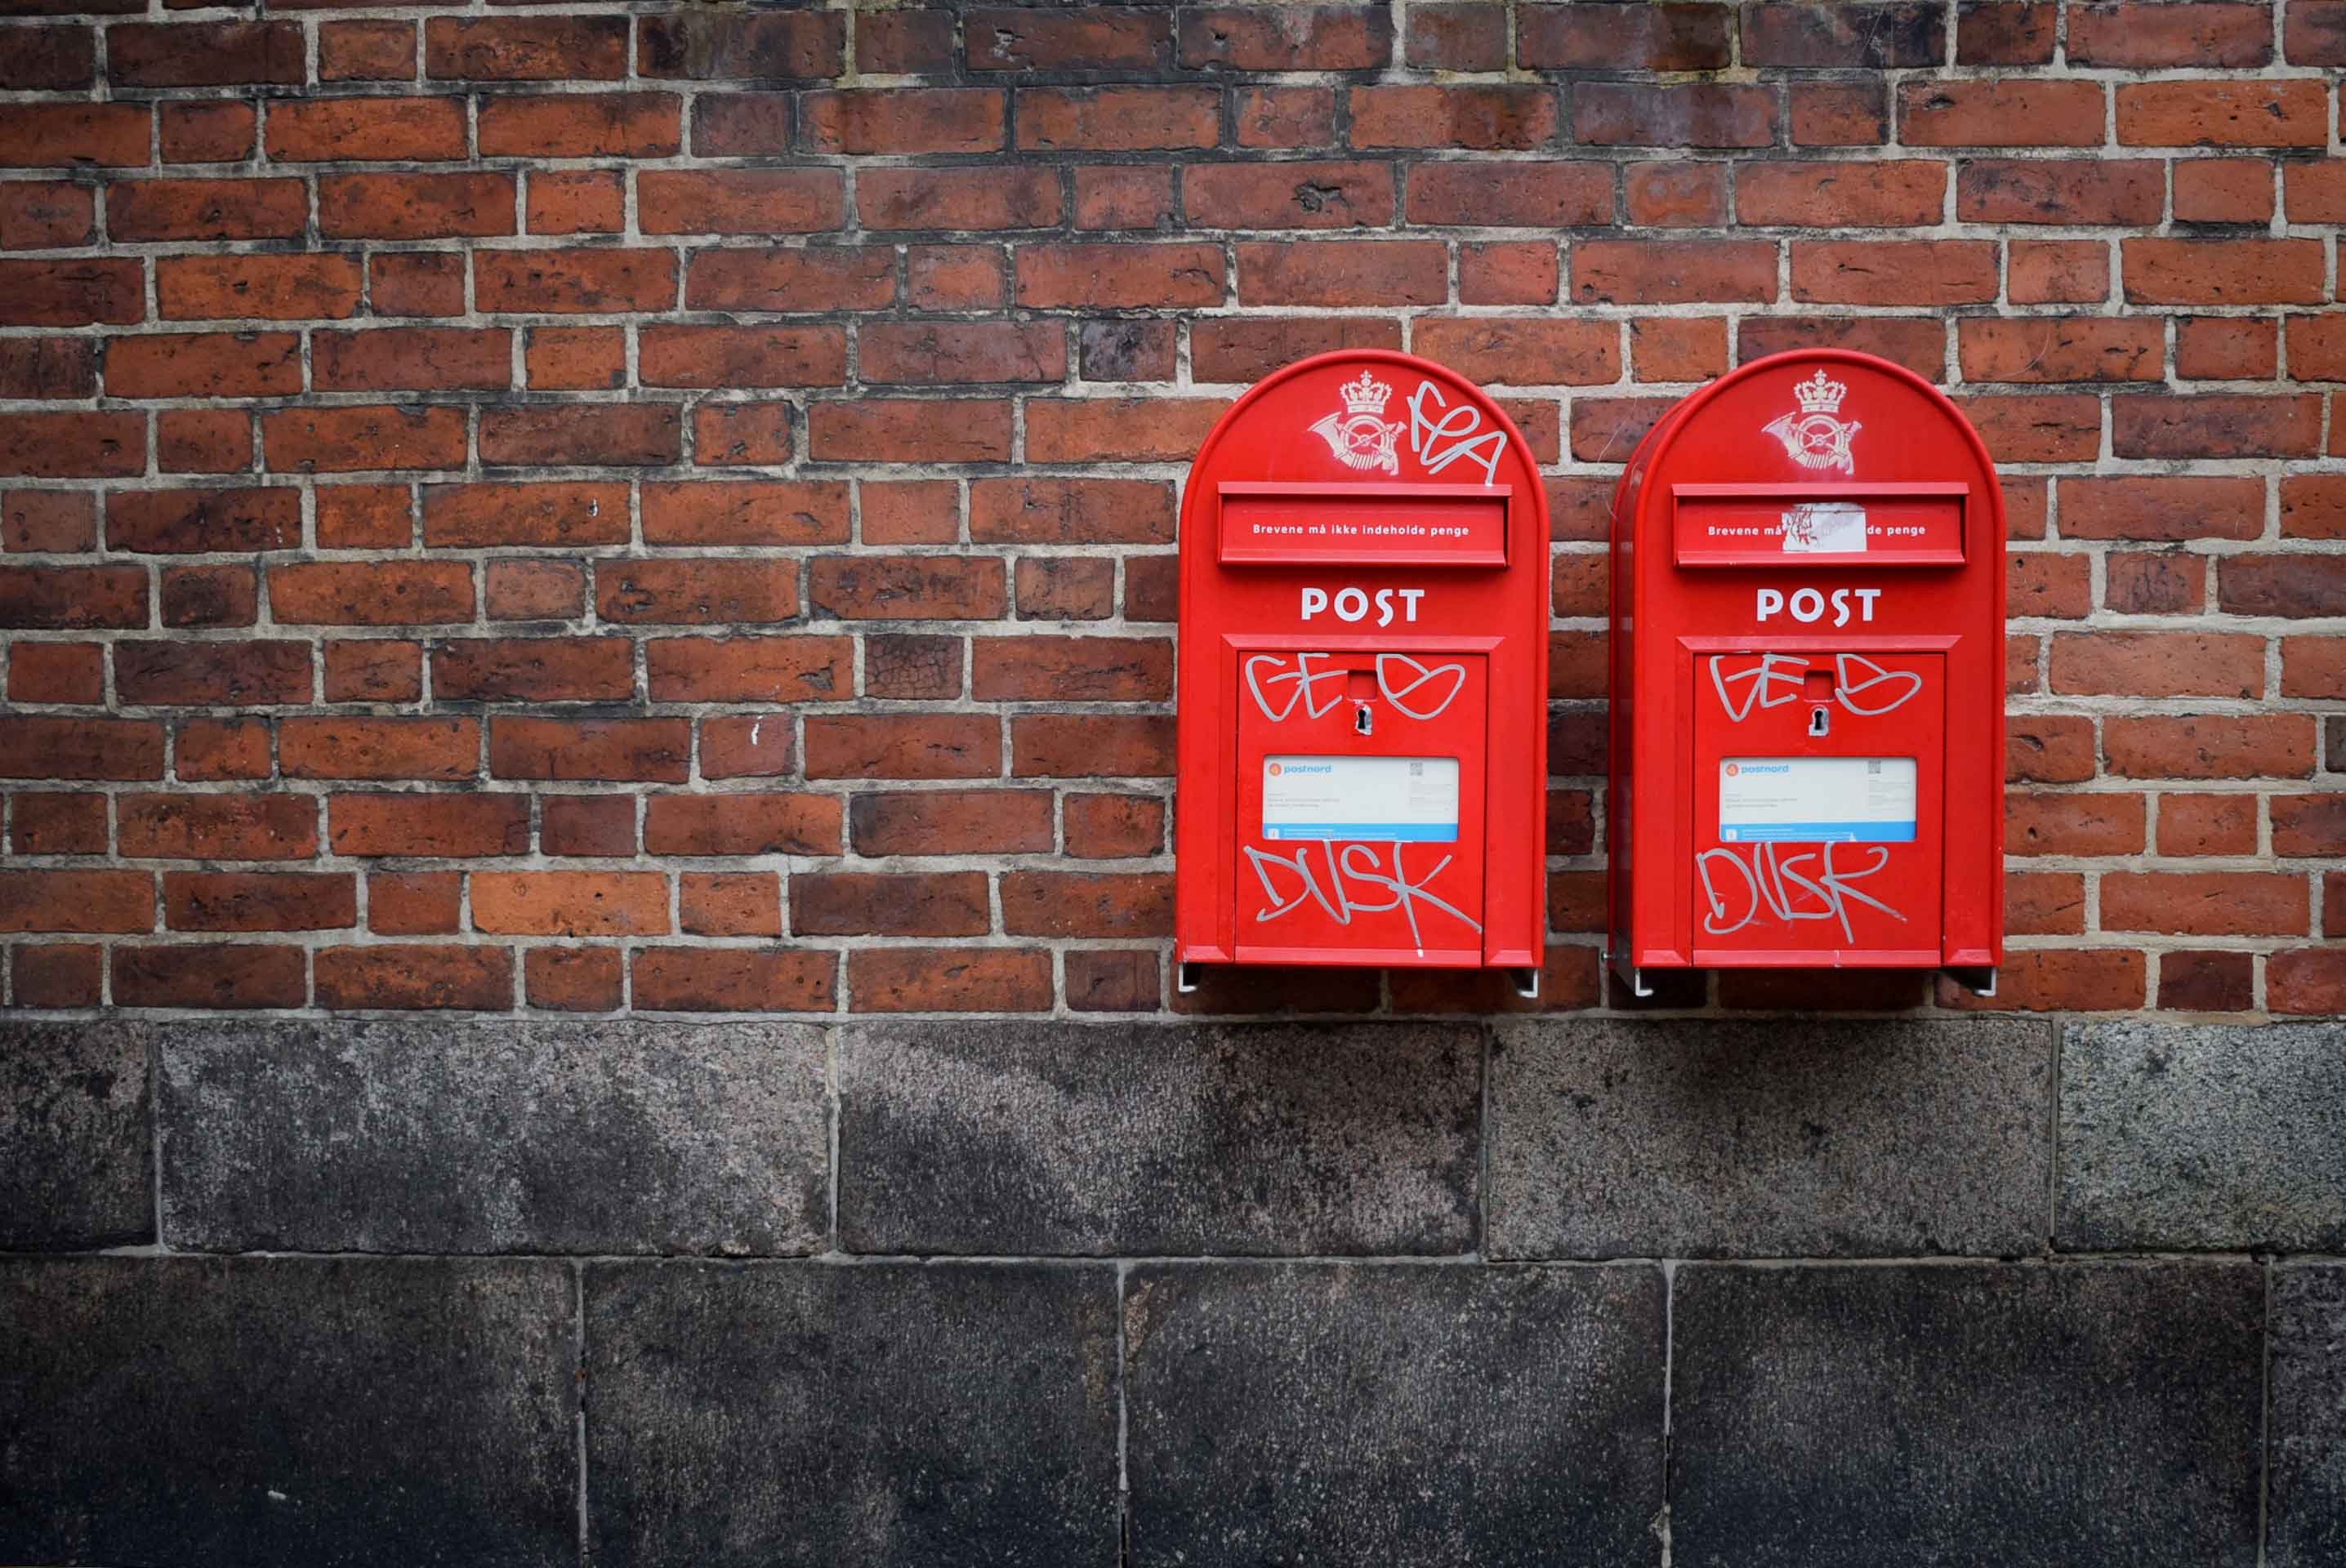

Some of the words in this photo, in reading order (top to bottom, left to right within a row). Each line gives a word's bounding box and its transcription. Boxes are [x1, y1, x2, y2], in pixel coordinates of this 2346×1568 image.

[1253, 523, 1304, 535] Brevene
[1309, 523, 1327, 535] må
[1331, 524, 1358, 535] ikke
[1363, 524, 1425, 536] indeholde
[1431, 527, 1469, 537] penge
[1708, 525, 1759, 536] Brevene
[1764, 525, 1782, 536] må
[1887, 526, 1926, 537] penge
[1301, 587, 1425, 628] POST
[1756, 587, 1881, 628] POST
[1283, 764, 1331, 774] postnord
[1741, 764, 1789, 775] postnord
